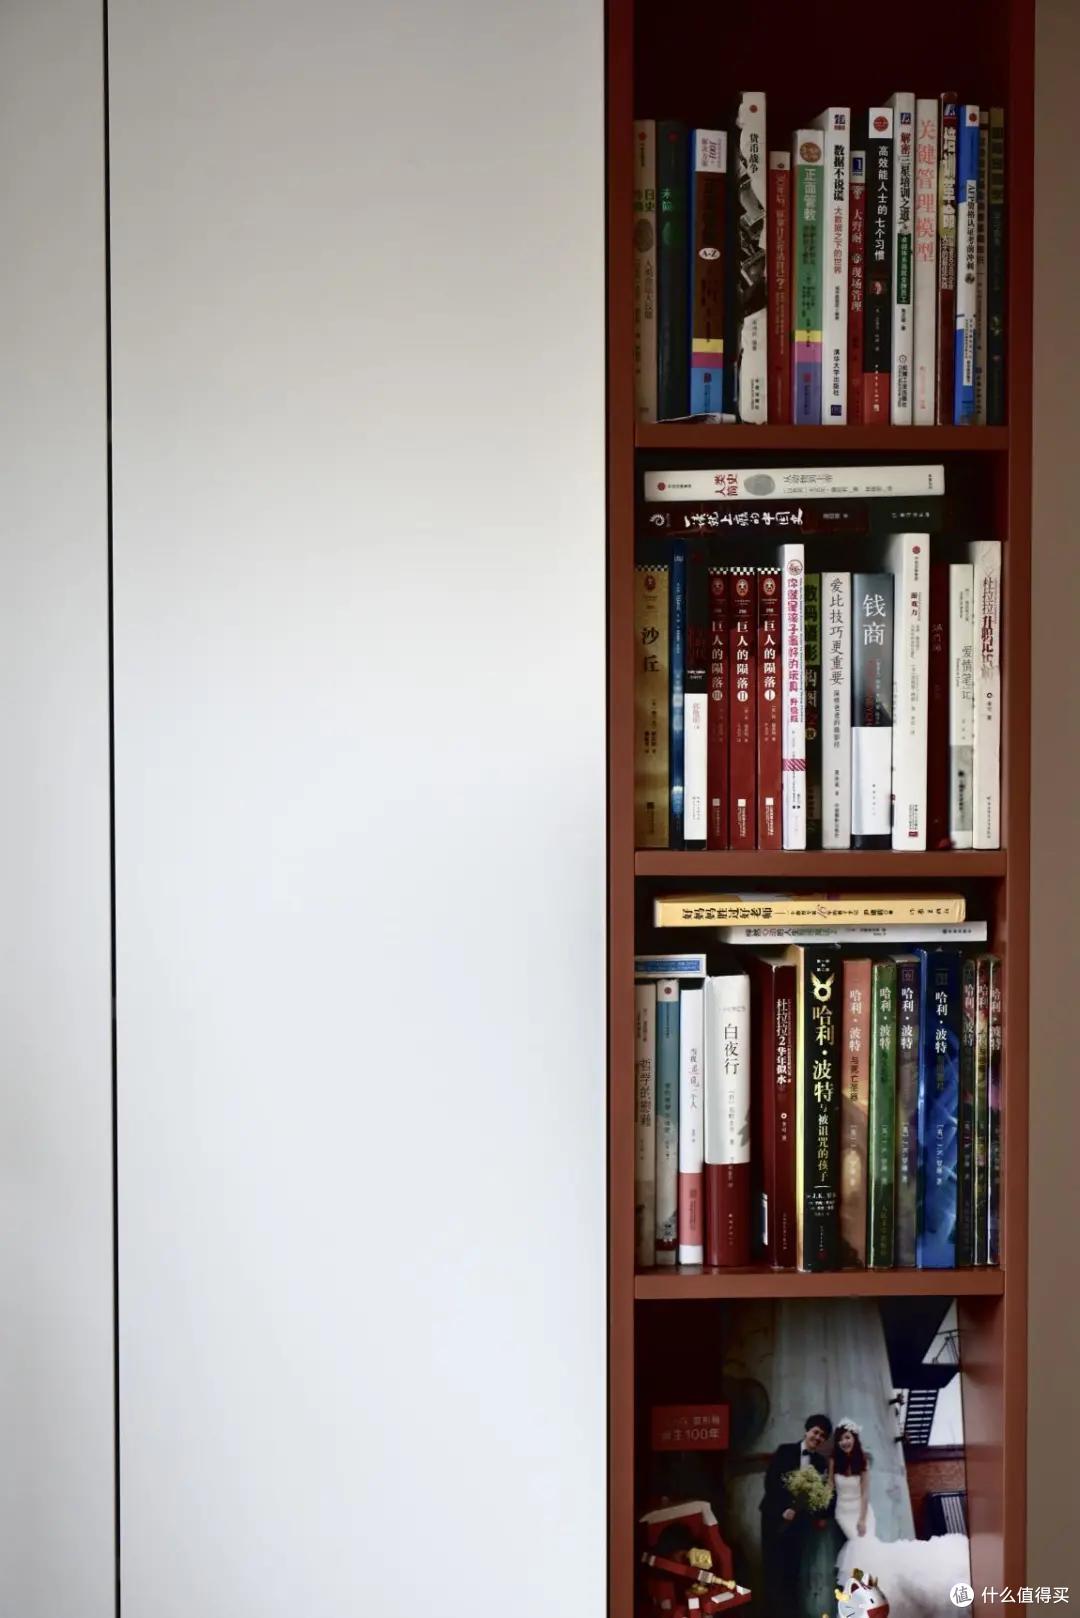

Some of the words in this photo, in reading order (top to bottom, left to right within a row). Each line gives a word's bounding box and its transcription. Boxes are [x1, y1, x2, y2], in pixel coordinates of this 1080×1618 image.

[750, 133, 759, 174] 货币战争
[833, 144, 845, 201] 数据不说谎
[803, 167, 817, 222] 正面管教
[873, 145, 890, 261] 高效能人士的七个习惯
[916, 119, 936, 263] 关键管理模型
[684, 508, 804, 529] 一读就上瘾的中国史
[829, 577, 845, 686] 爱比技巧更重要
[863, 593, 887, 646] 钱商
[711, 621, 723, 689] 巨人的陨落
[736, 621, 748, 689] 巨人的陨落
[764, 620, 776, 689] 巨人的陨落
[682, 907, 774, 919] 好妈妈胜过好老师
[724, 1023, 739, 1074] 白夜行
[812, 1004, 835, 1103] 哈利·波特
